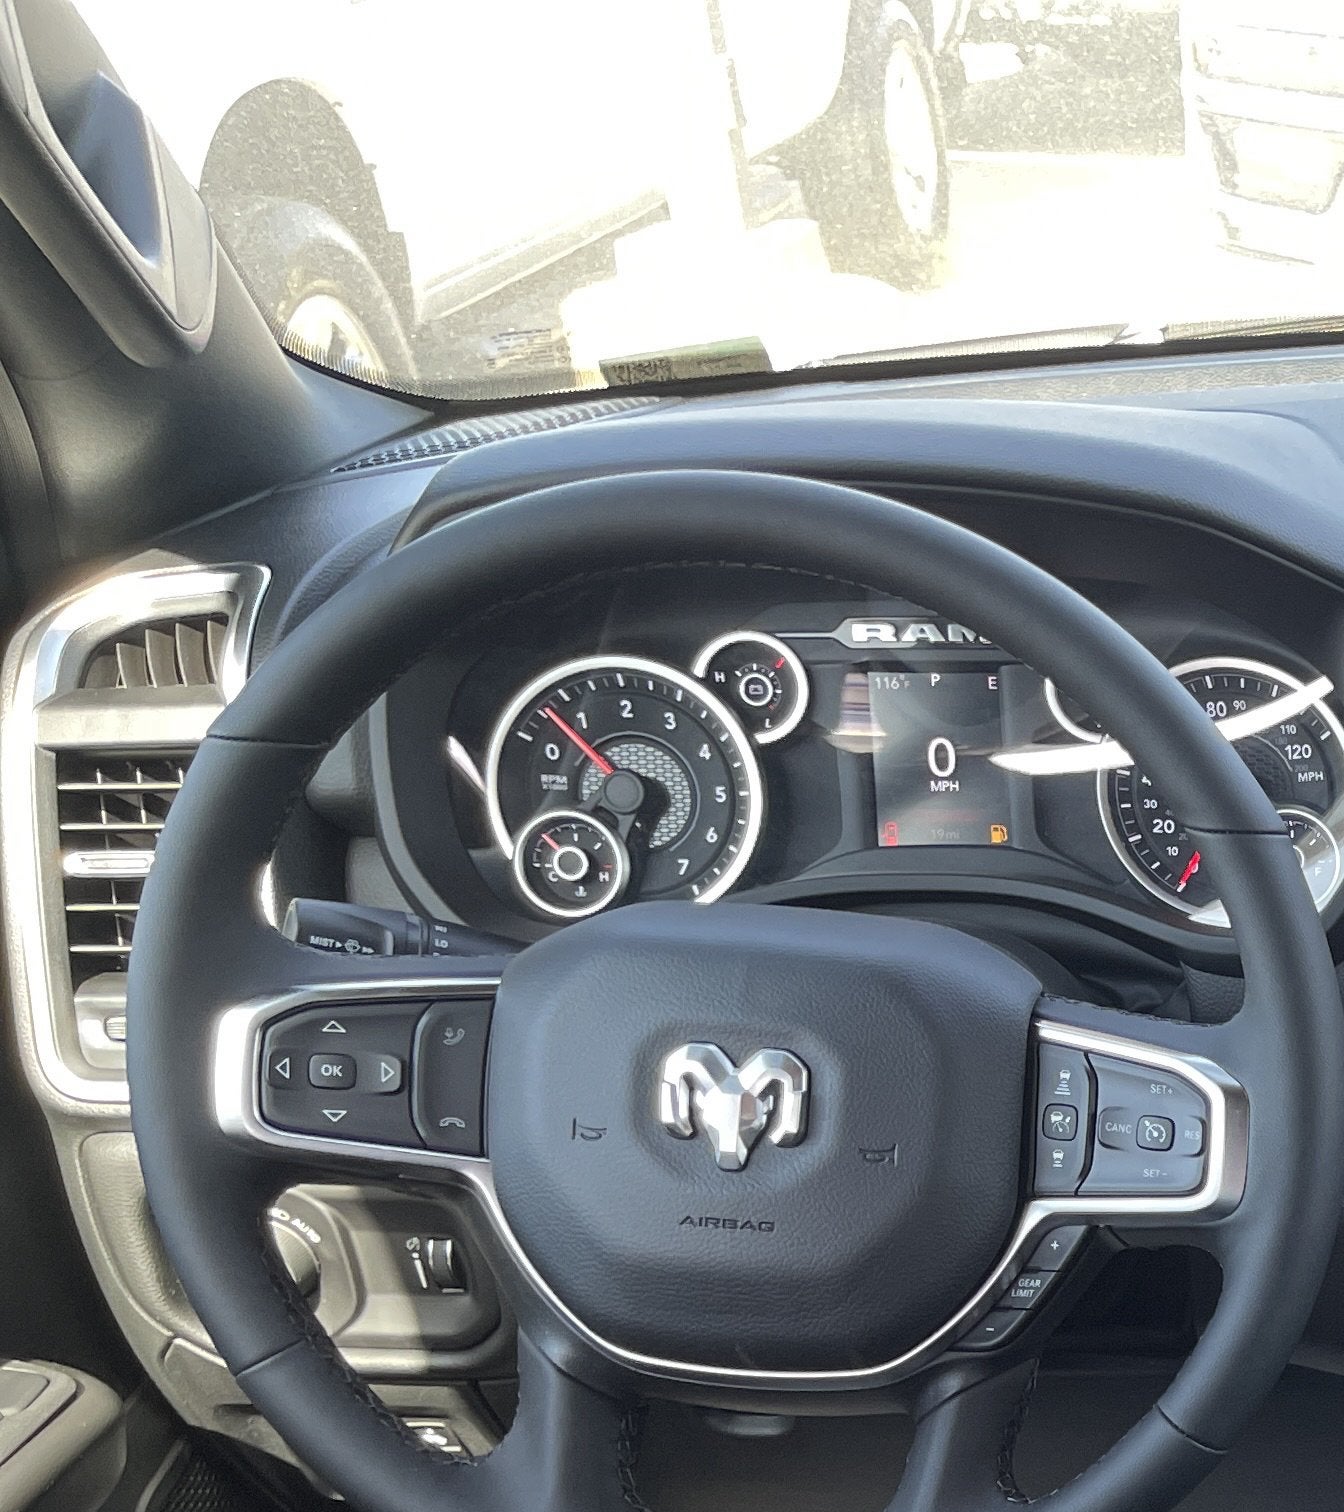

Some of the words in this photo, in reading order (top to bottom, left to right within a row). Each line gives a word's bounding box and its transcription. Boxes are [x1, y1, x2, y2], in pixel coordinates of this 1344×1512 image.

[714, 672, 726, 682] H
[931, 674, 941, 687] P
[989, 677, 998, 689] E
[619, 700, 634, 718] 2
[1206, 701, 1227, 718] 80
[1233, 700, 1246, 711] 90
[576, 711, 588, 729] 1
[664, 712, 676, 729] 3
[765, 718, 772, 728] L
[1280, 725, 1297, 735] 110
[545, 743, 560, 760] 0
[699, 744, 711, 760] 4
[928, 737, 956, 777] 0
[1285, 744, 1312, 760] 120
[1298, 771, 1324, 783] MPH
[930, 781, 959, 792] MPH
[715, 786, 727, 802] 5
[1144, 799, 1158, 809] 30
[1153, 819, 1175, 834] 20
[705, 827, 718, 843] 6
[1166, 846, 1179, 856] 10
[677, 859, 690, 875] 7
[599, 872, 609, 882] H
[310, 935, 334, 948] MIST
[435, 938, 448, 948] LO
[321, 1064, 342, 1077] OK
[1105, 1122, 1132, 1134] CANC
[1184, 1129, 1200, 1139] RES
[679, 1216, 776, 1232] AIRBAG
[1018, 1279, 1041, 1288] GEAR
[1011, 1289, 1035, 1298] LIMIT
